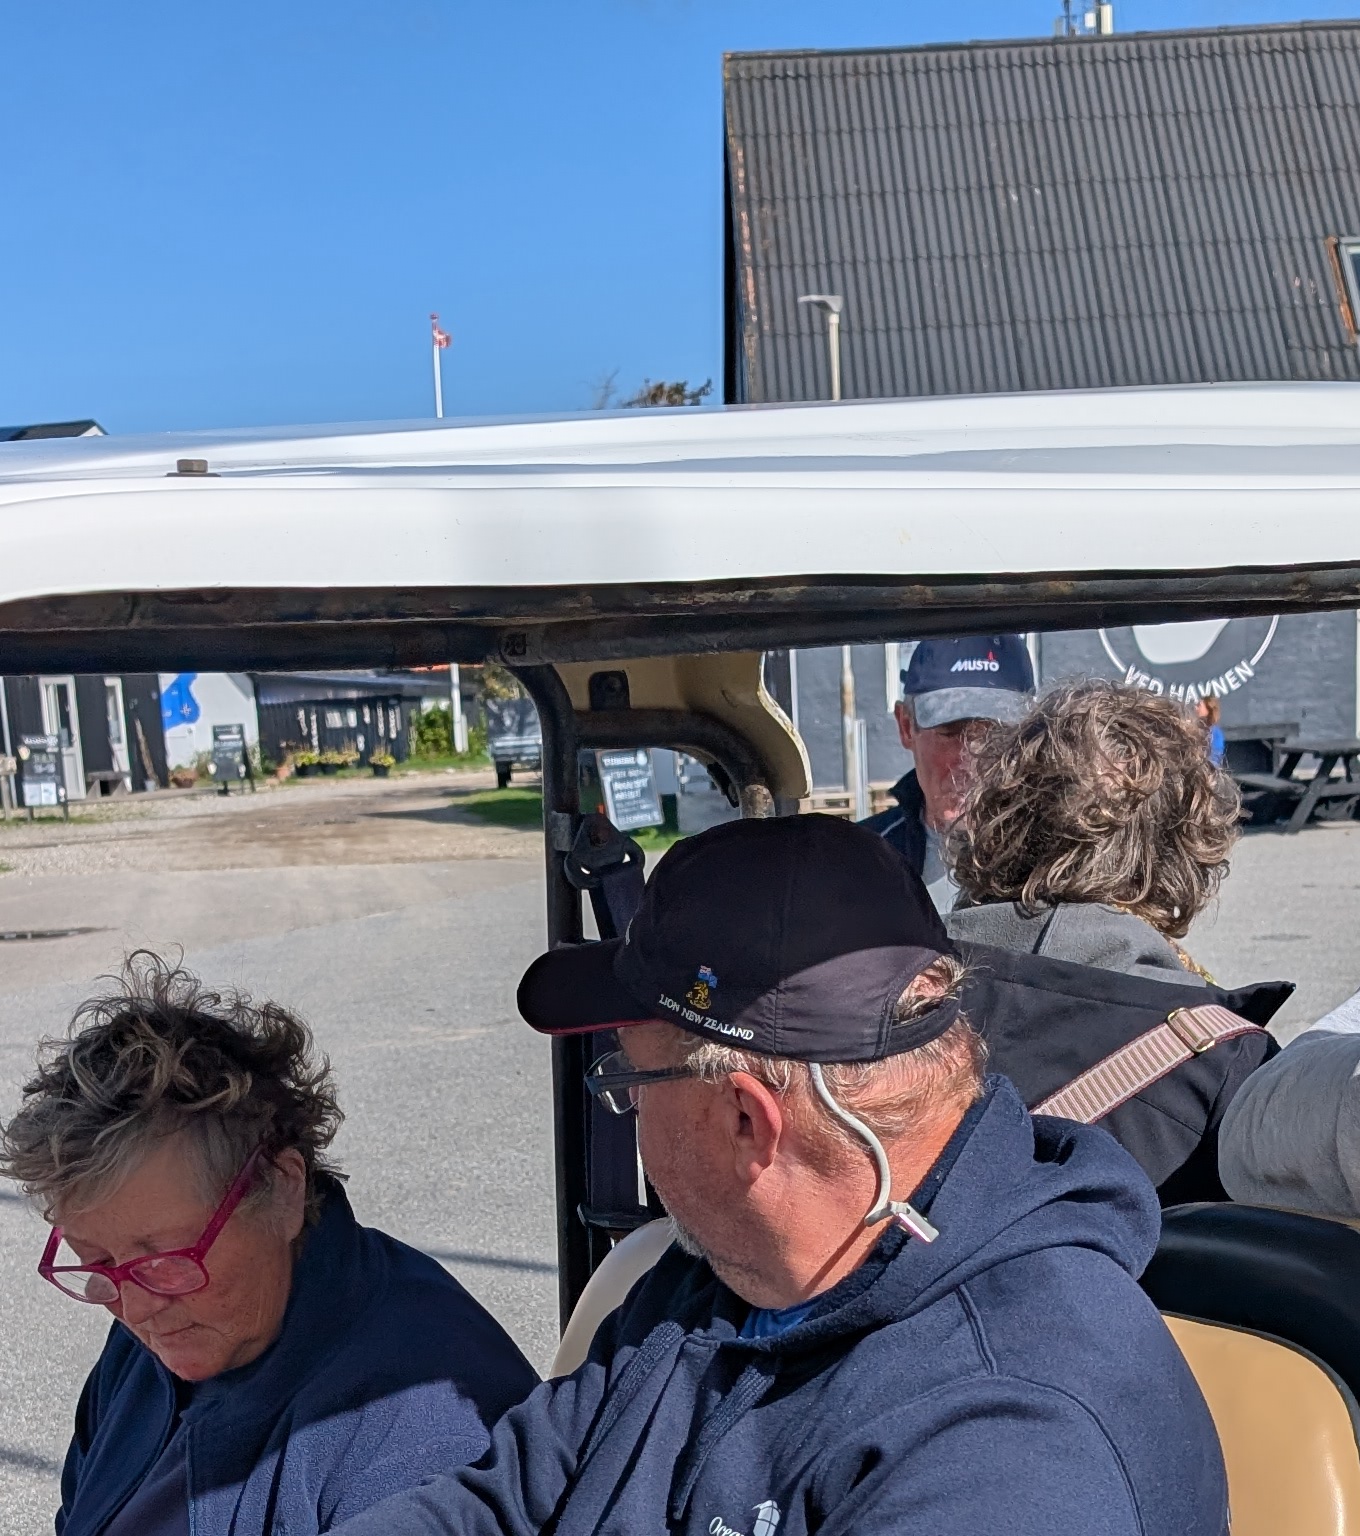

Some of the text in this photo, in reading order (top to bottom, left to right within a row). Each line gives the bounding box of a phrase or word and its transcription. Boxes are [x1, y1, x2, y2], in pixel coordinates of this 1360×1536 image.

[950, 659, 1000, 672] MUSTO
[1169, 658, 1255, 705] HAVNEN
[659, 993, 755, 1040] LION NEW ZEALAND
